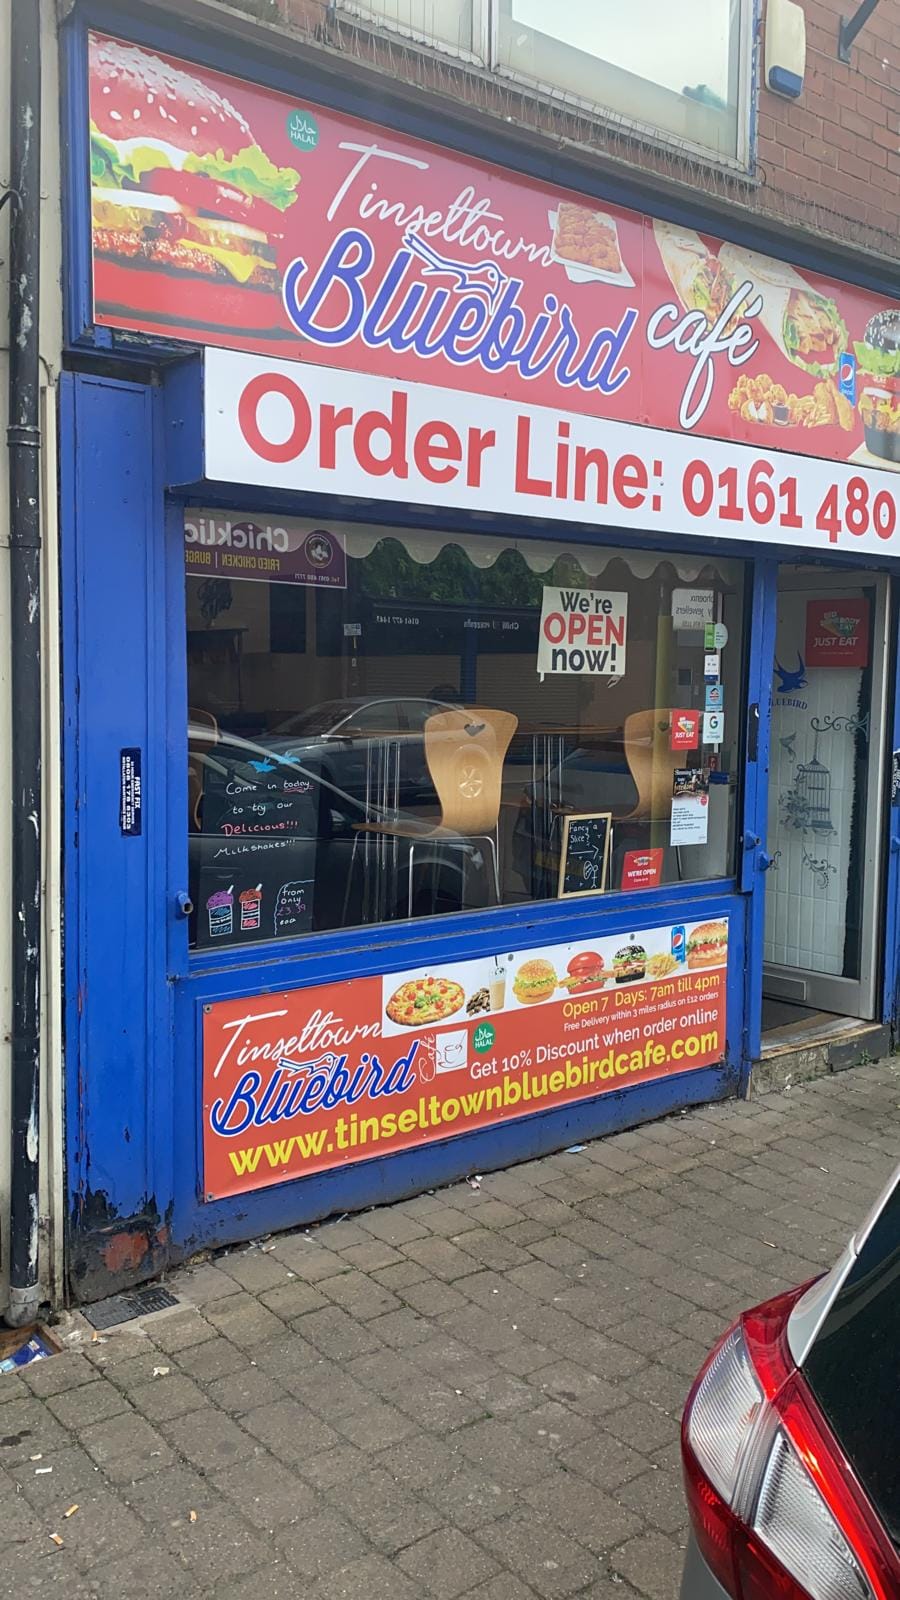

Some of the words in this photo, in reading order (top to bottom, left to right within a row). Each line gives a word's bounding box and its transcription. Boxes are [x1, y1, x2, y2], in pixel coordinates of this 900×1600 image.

[290, 131, 317, 146] HALAL
[327, 142, 556, 267] Tinseltown
[282, 228, 639, 395] Bluebird
[647, 280, 764, 430] café
[238, 372, 496, 488] Order
[515, 415, 662, 512] Line:
[682, 459, 803, 529] 0161
[815, 475, 897, 544] 480
[560, 591, 613, 614] We're
[543, 612, 625, 647] OPEN
[813, 637, 837, 647] JUST
[838, 636, 859, 646] EAT
[551, 643, 617, 672] now!
[225, 782, 257, 795] Come
[283, 780, 310, 791] today
[232, 806, 244, 814] to
[252, 803, 266, 816] try
[569, 821, 589, 834] Fancy
[642, 868, 657, 876] OPEN
[280, 896, 302, 907] only
[281, 885, 305, 897] from
[562, 1000, 598, 1020] Open
[601, 997, 609, 1013] 7
[615, 988, 648, 1009] Days:
[650, 983, 675, 1002] 7am
[677, 974, 693, 993] till
[694, 973, 720, 995] 4pm
[564, 1022, 580, 1032] Free
[581, 1014, 610, 1029] Delivery
[610, 1009, 632, 1021] within
[632, 1008, 638, 1018] 3
[638, 1003, 657, 1016] miles
[657, 998, 677, 1011] radius
[677, 997, 686, 1007] on
[686, 995, 698, 1005] £12
[699, 991, 719, 1002] orders
[214, 1009, 383, 1078] Tinseltown
[470, 1057, 499, 1080] Get
[501, 1048, 532, 1073] 10%
[536, 1033, 600, 1064] Discount
[602, 1025, 640, 1050] when
[643, 1016, 677, 1038] order
[679, 1007, 718, 1029] online
[474, 1039, 494, 1049] HALAL
[210, 1039, 421, 1138] Bluebird
[228, 1030, 718, 1177] www.tinseltownbluebirdcafe.com
